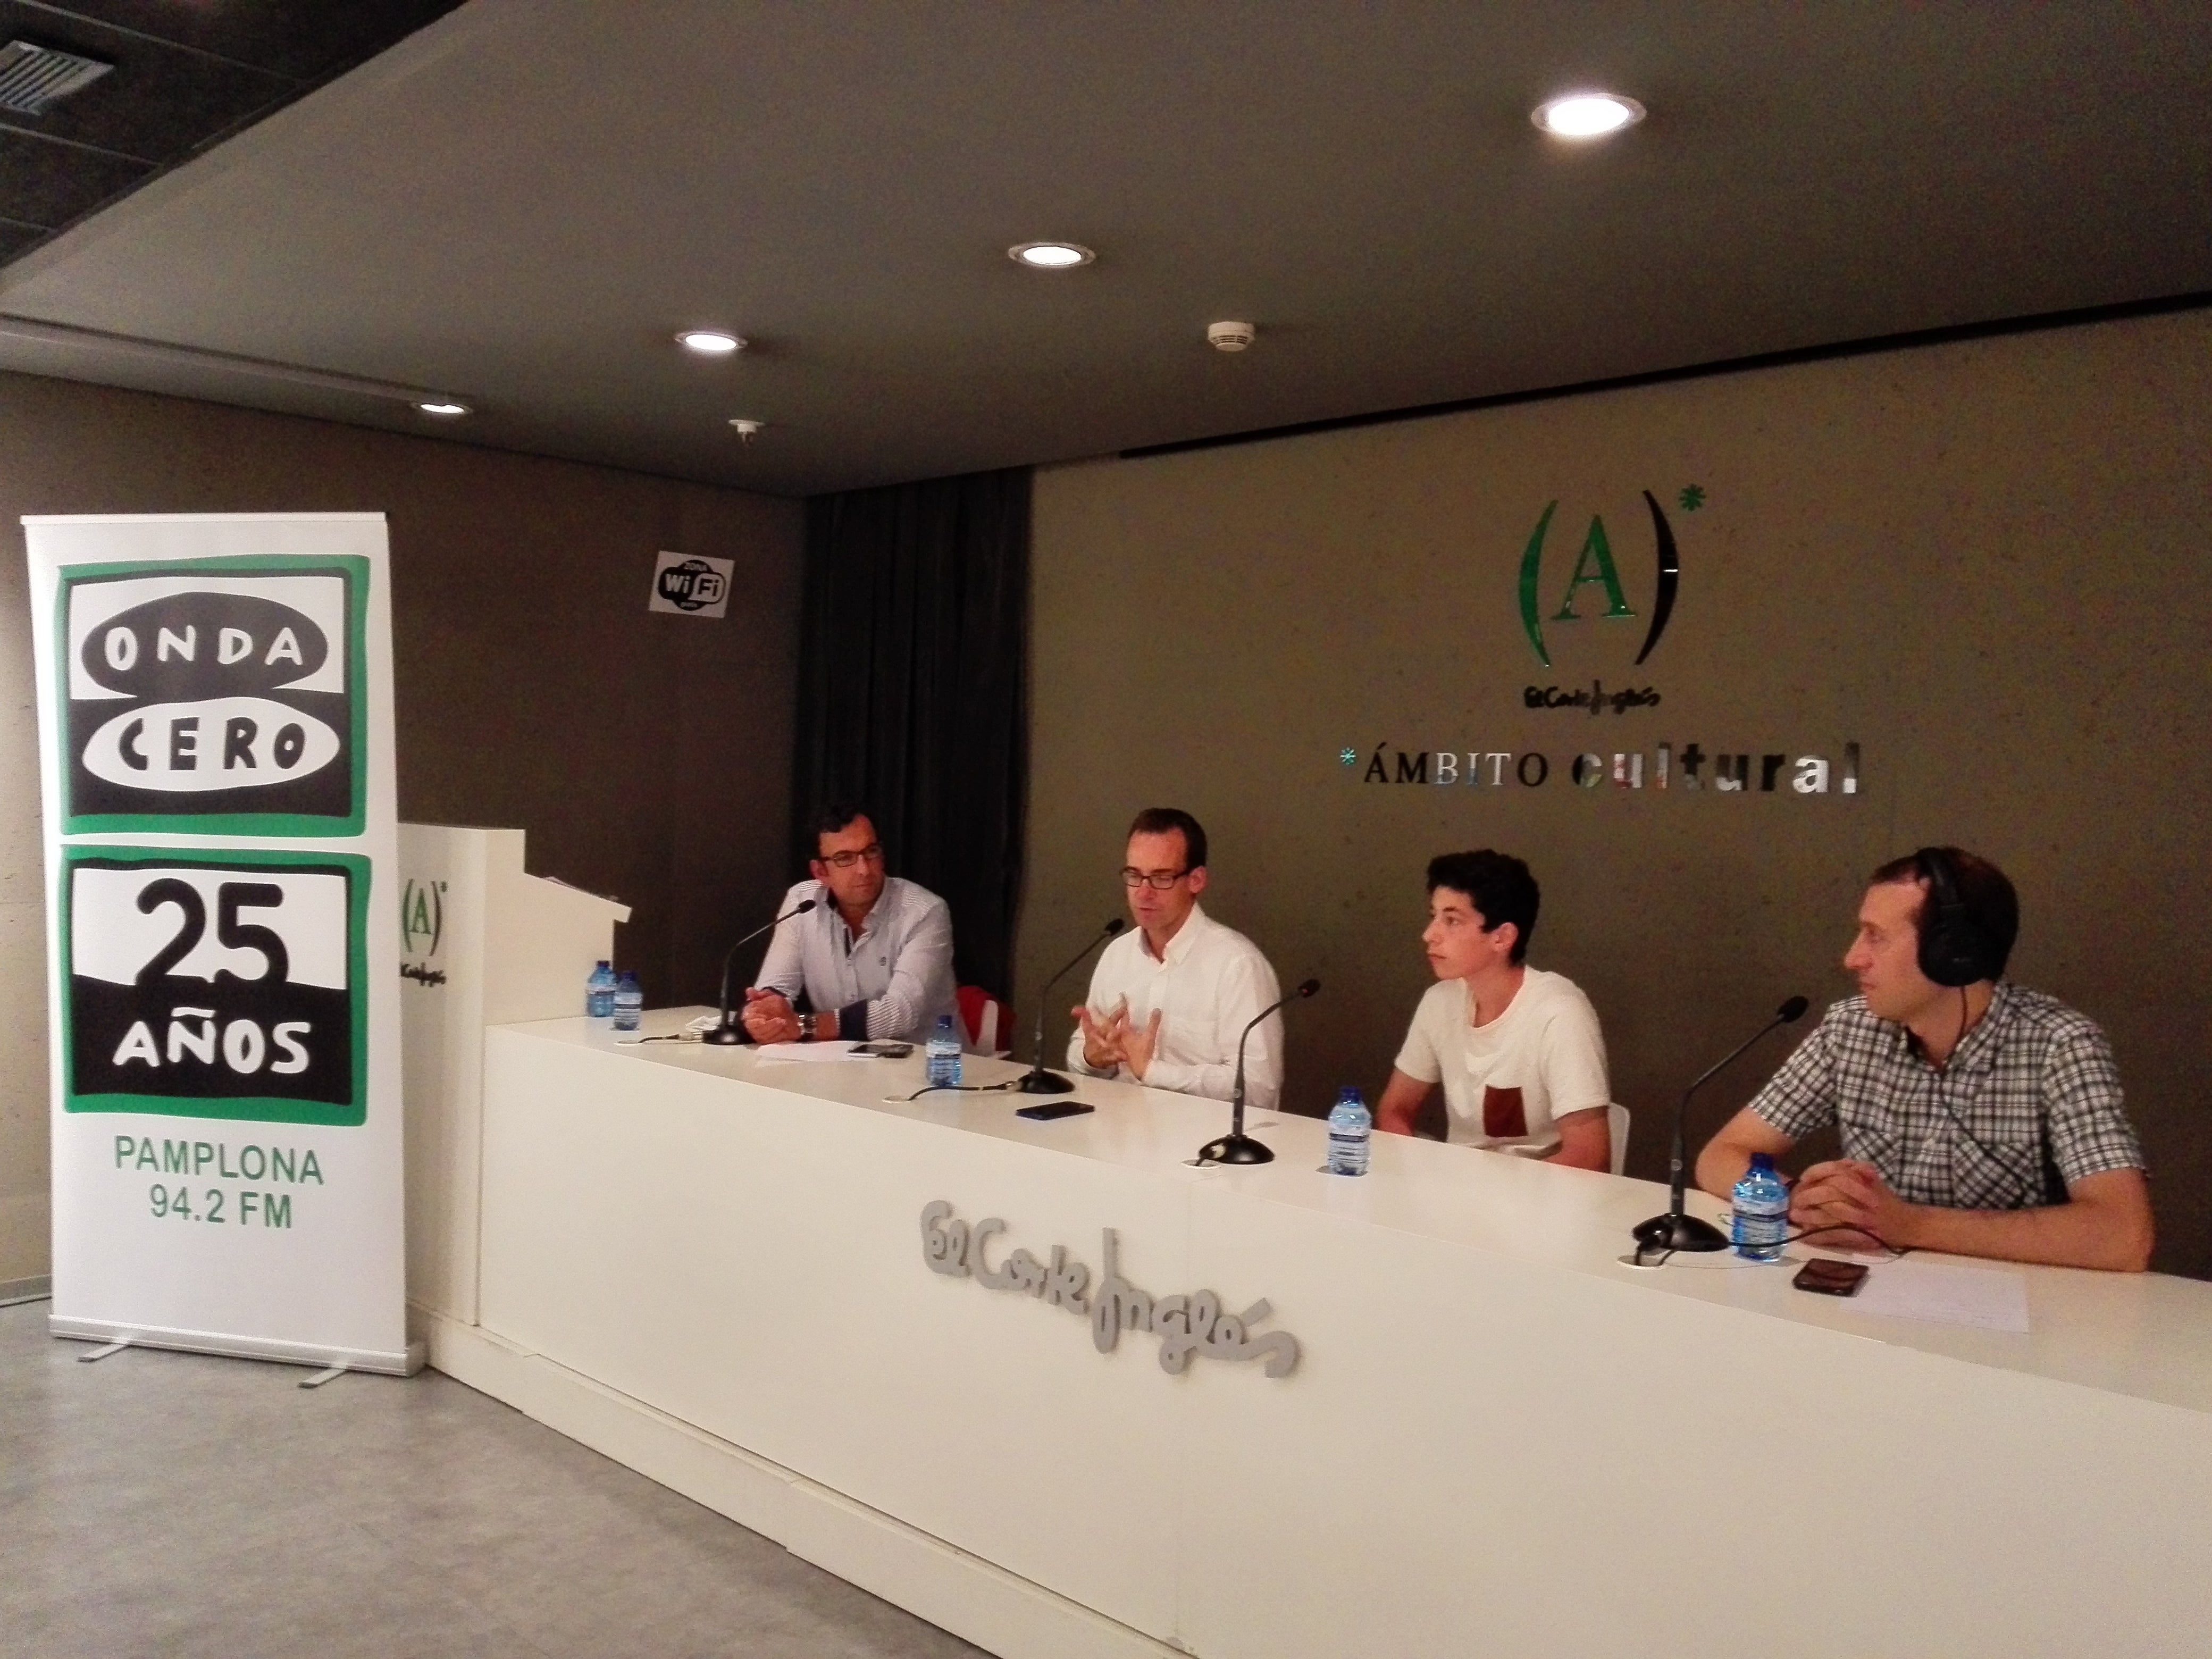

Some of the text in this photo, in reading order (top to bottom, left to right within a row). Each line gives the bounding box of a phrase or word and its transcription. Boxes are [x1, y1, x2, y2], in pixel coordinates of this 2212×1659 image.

[105, 625, 303, 671] ONDA
[119, 716, 306, 771] CERO
[1364, 742, 1860, 794] ÁMBITO cultural
[135, 877, 289, 992] 25
[112, 1007, 311, 1074] AÑOS
[114, 1135, 324, 1186] PAMPLONA
[149, 1184, 292, 1228] 94.2 FM
[971, 1217, 1091, 1315] Corte
[1092, 1227, 1301, 1378] Inglés
